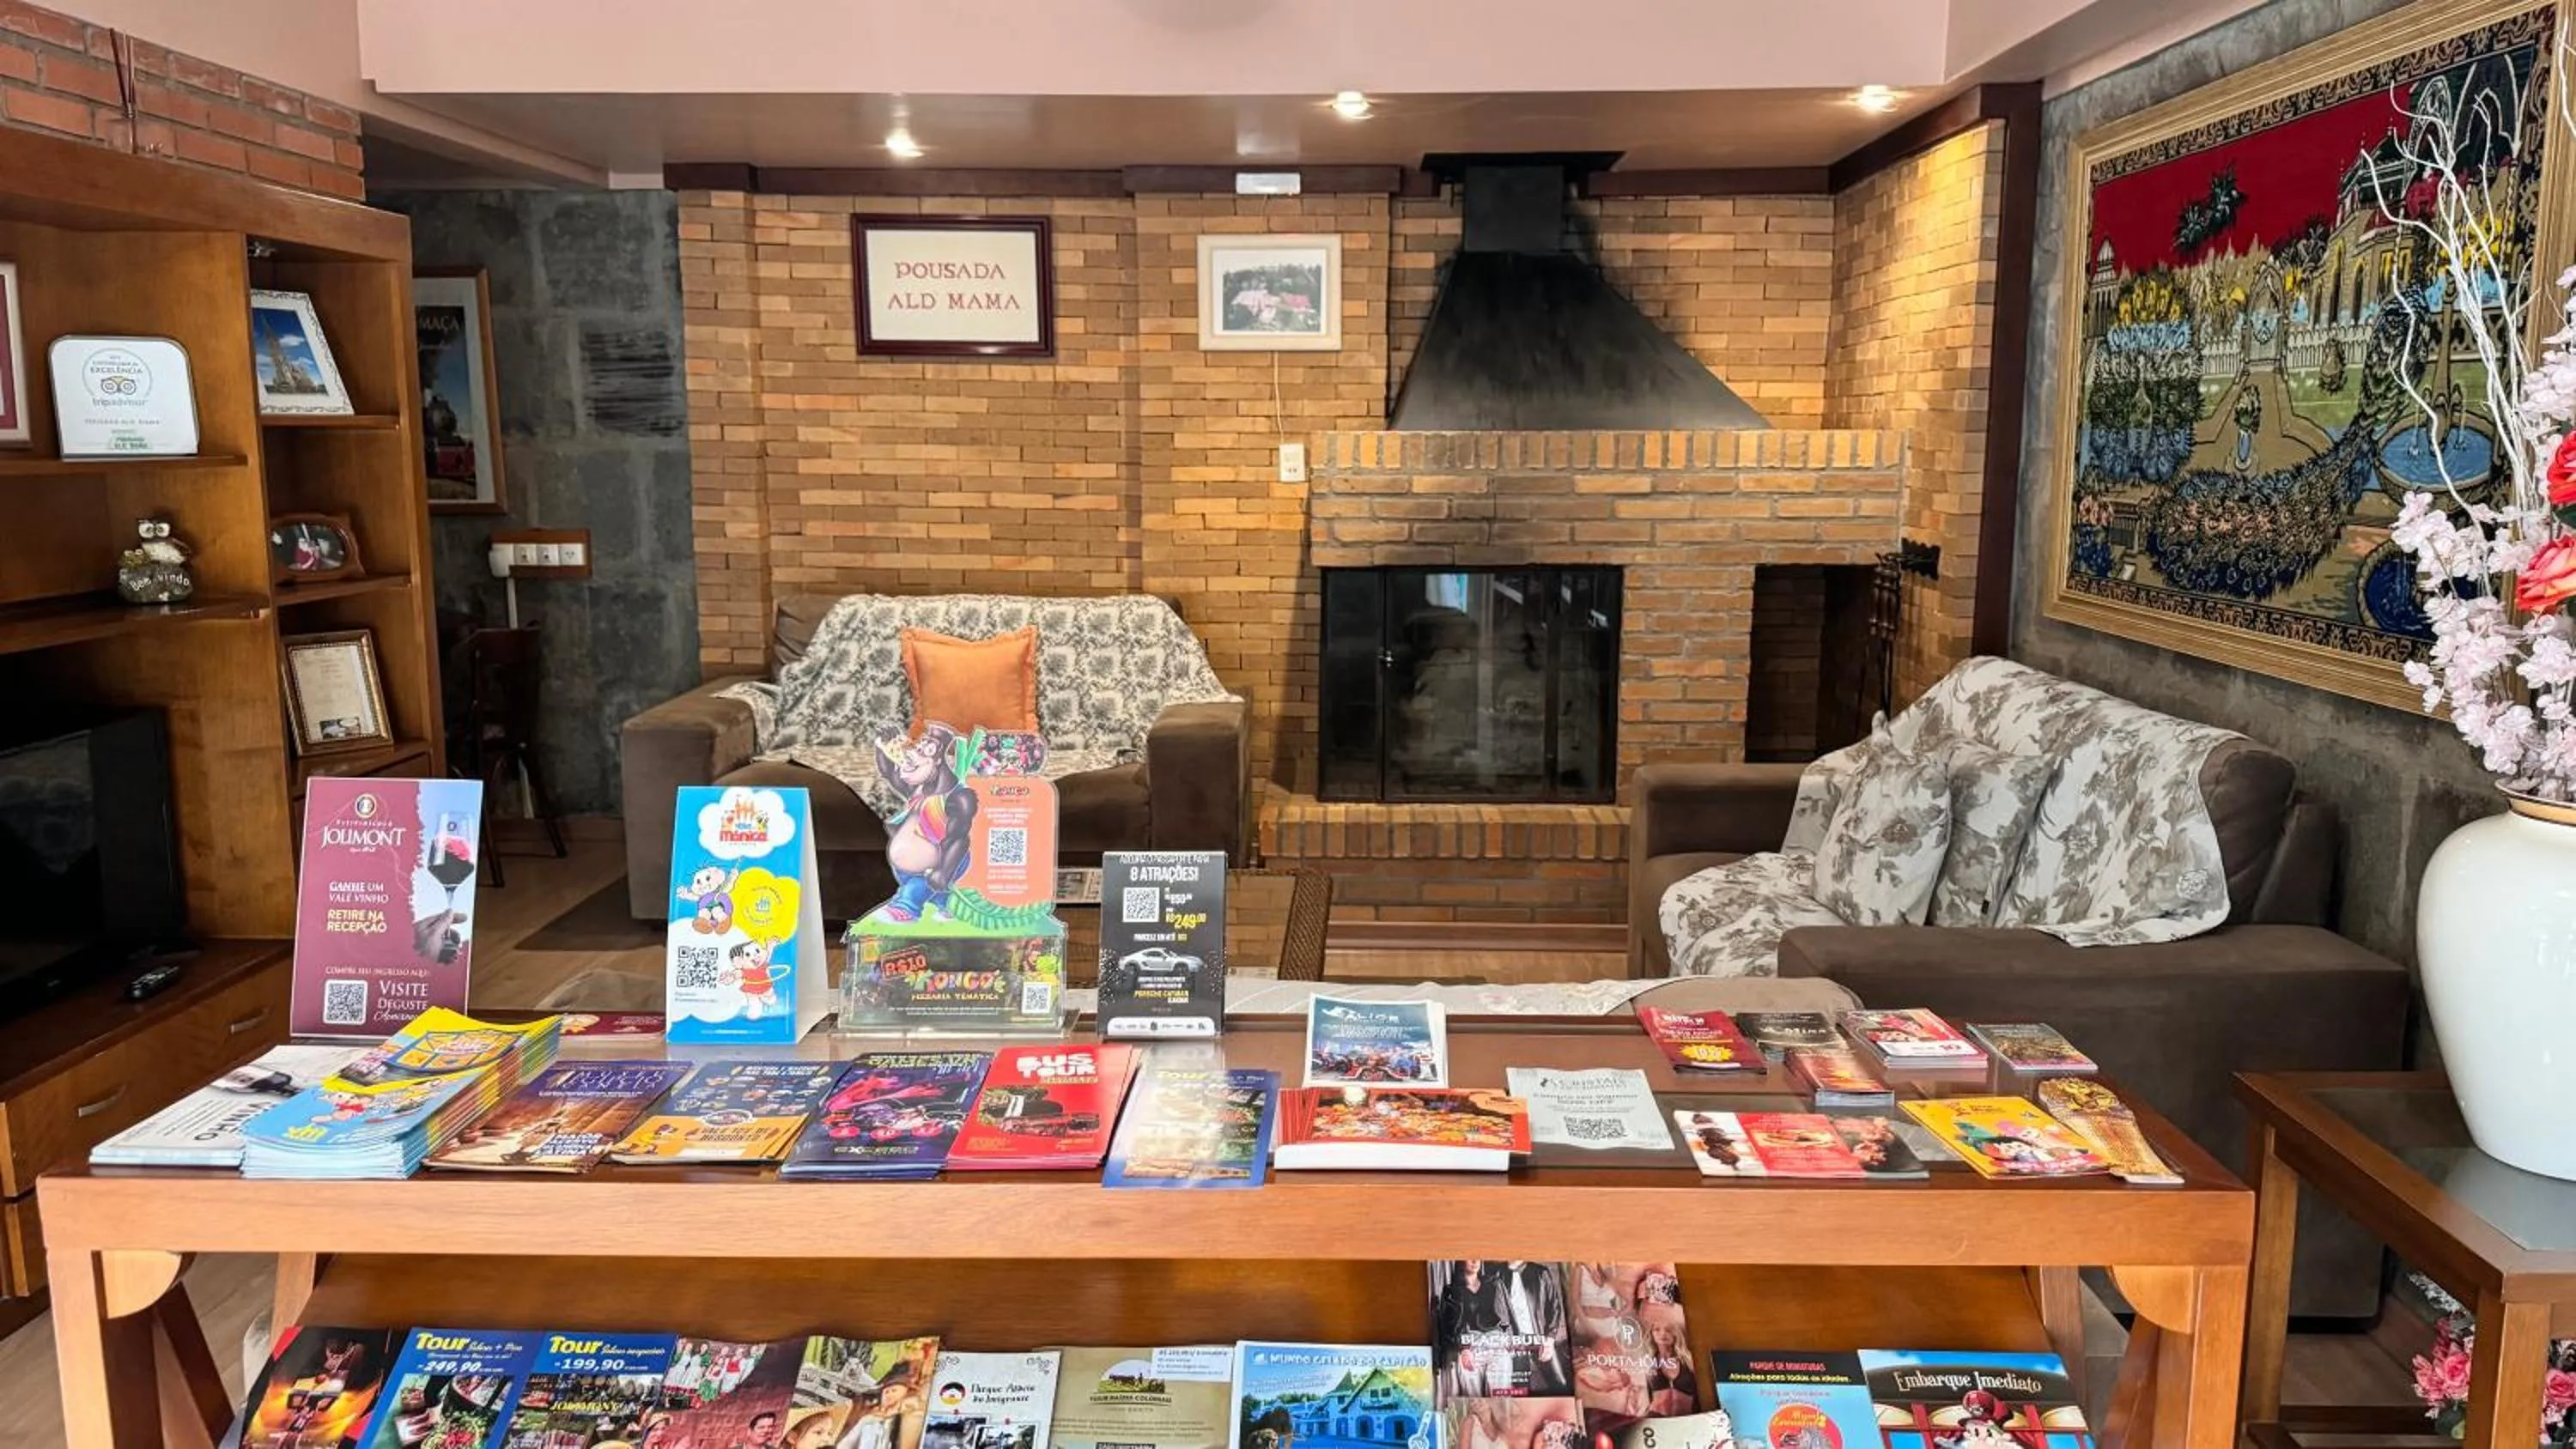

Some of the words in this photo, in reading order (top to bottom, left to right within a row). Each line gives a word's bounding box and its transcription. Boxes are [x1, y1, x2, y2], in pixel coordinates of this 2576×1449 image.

[895, 262, 1005, 280] POUSADA
[887, 292, 936, 310] ALD
[947, 292, 1020, 310] MAMA
[320, 826, 407, 848] JOLIMONT
[1139, 865, 1199, 883] ATRAÇÕES!
[329, 882, 366, 891] GANHE
[328, 910, 366, 920] RETIRE
[368, 911, 385, 921] NA
[379, 979, 428, 997] VISITE
[378, 997, 428, 1009] DEGUSTE
[1017, 1052, 1094, 1070] BUS
[1019, 1064, 1097, 1078] TOUR
[416, 1331, 470, 1350] Tour
[550, 1335, 604, 1355] Tour
[1461, 1334, 1510, 1346] BLACK
[1512, 1335, 1552, 1346] BULL
[423, 1361, 482, 1373] 249,90
[561, 1359, 625, 1372] 199,90
[1270, 1354, 1310, 1365] MUNDO
[1893, 1371, 1972, 1391] Embarque
[1974, 1371, 2042, 1393] Imediato
